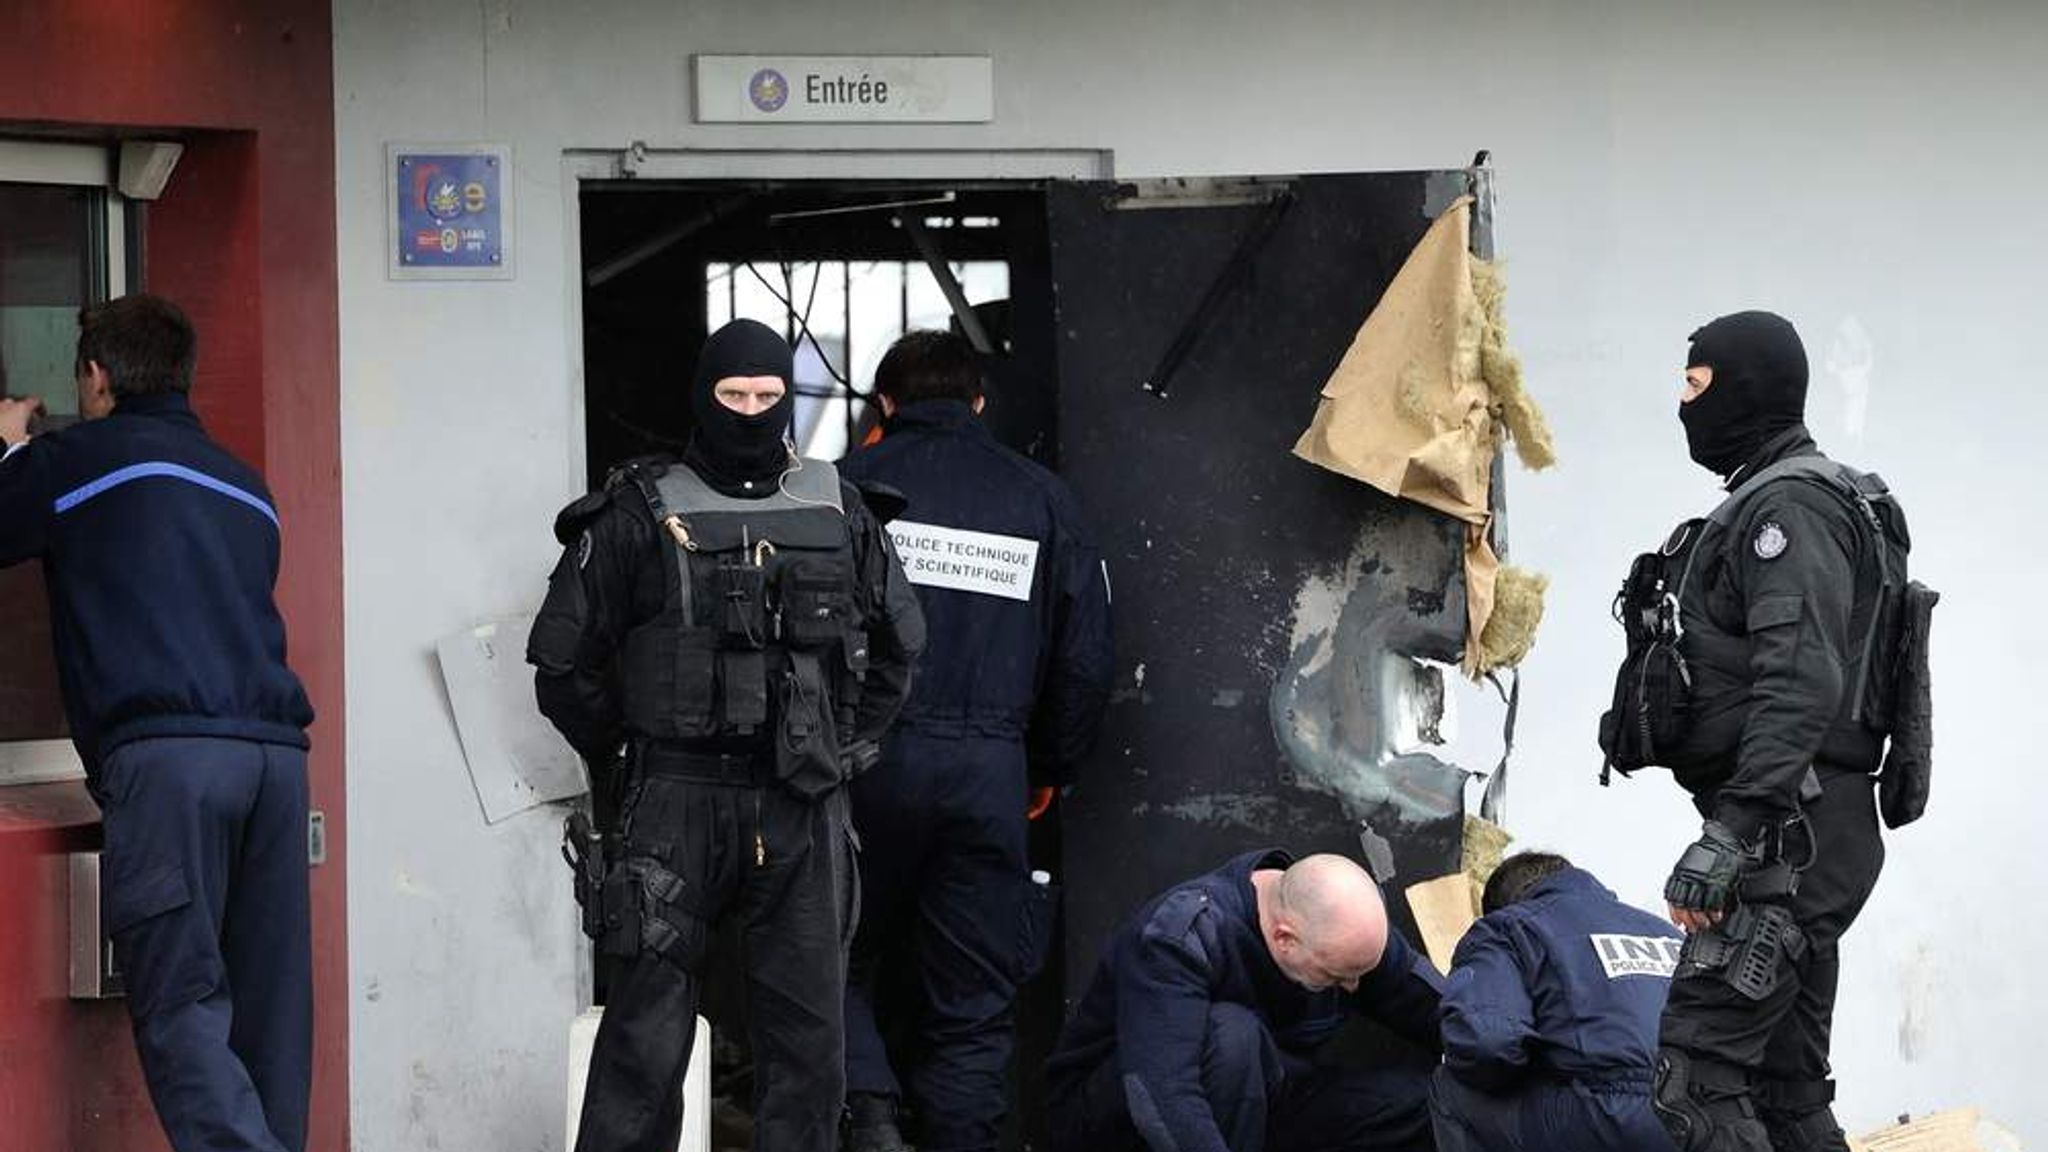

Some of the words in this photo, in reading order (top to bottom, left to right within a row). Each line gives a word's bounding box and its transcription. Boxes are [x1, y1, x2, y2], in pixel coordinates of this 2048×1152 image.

[806, 74, 888, 104] Entrée
[894, 534, 941, 552] OLICE
[947, 542, 1029, 566] TECHNIQUE
[914, 557, 1017, 585] SCIENTIFIQUE
